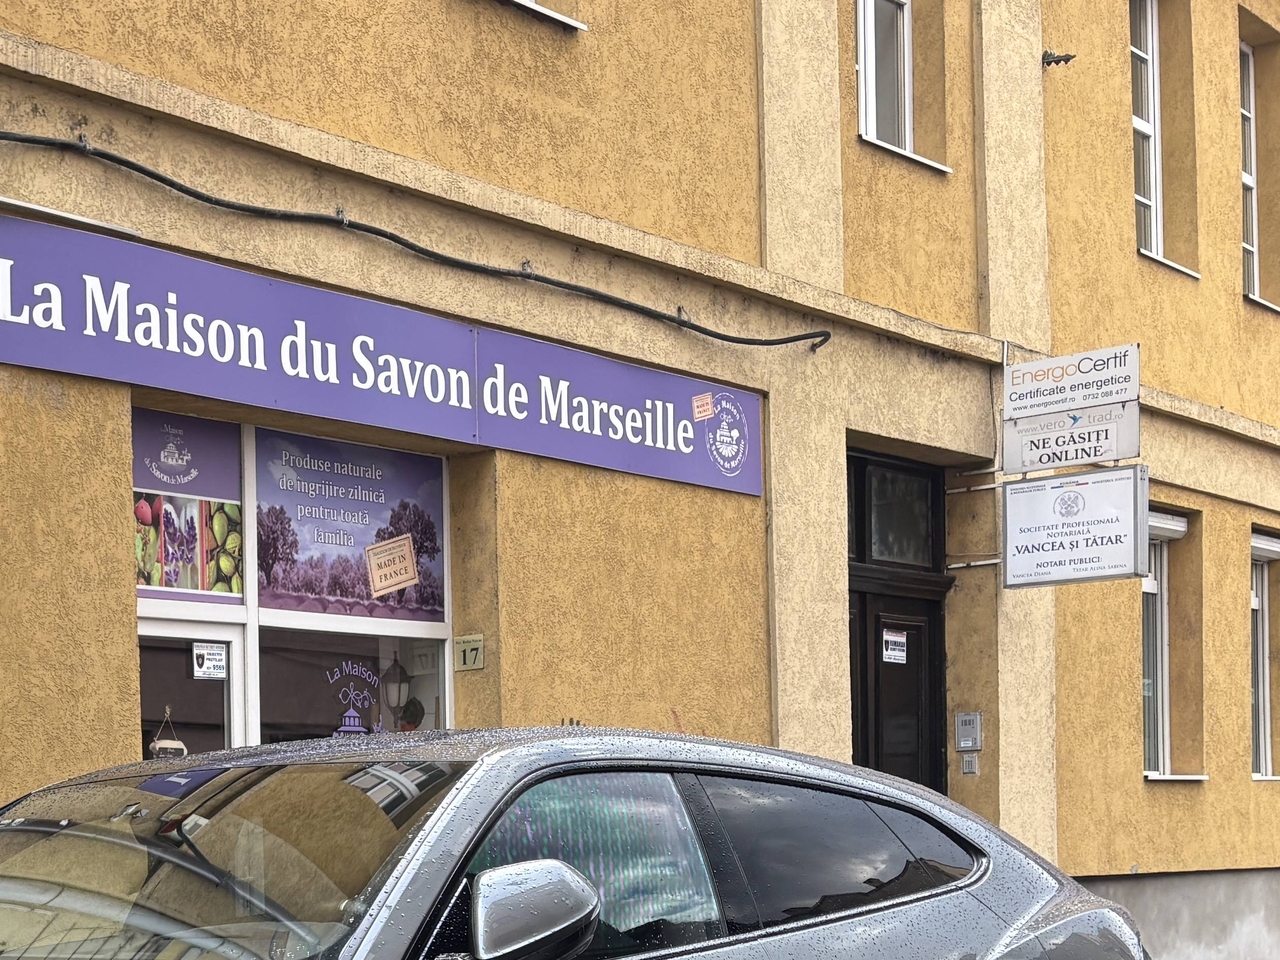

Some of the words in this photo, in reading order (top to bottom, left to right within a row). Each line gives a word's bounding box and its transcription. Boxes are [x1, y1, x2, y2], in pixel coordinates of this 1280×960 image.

[82, 274, 268, 371] Maison
[280, 319, 340, 384] du
[352, 335, 473, 410] Savon
[483, 363, 529, 420] de
[538, 375, 695, 454] Marseille
[1011, 350, 1129, 387] EnergoCertif
[1009, 384, 1067, 403] Certificate
[1070, 374, 1132, 392] energetice
[713, 404, 721, 414] La
[721, 400, 740, 420] Maison
[1012, 396, 1076, 412] www.energocertif.ro
[1082, 392, 1100, 401] 0732
[1114, 388, 1128, 396] 477
[1029, 437, 1052, 451] NE
[1055, 429, 1110, 447] GĂSIȚI
[281, 450, 332, 473] Produse
[334, 460, 383, 480] naturale
[1039, 445, 1104, 464] ONLINE
[150, 462, 170, 484] Savon
[279, 473, 294, 491] de
[297, 475, 346, 500] îngrijire
[348, 484, 386, 504] zilnică
[297, 503, 338, 522] pentru
[340, 506, 370, 526] toată
[314, 525, 355, 547] familia
[1047, 528, 1091, 539] NOTARIALĂ
[376, 556, 398, 571] MADE
[398, 553, 407, 564] IN
[1036, 560, 1067, 569] NOTARI
[379, 565, 410, 583] FRANCE
[461, 647, 480, 666] 17
[326, 667, 341, 684] La
[342, 660, 379, 688] Maison
